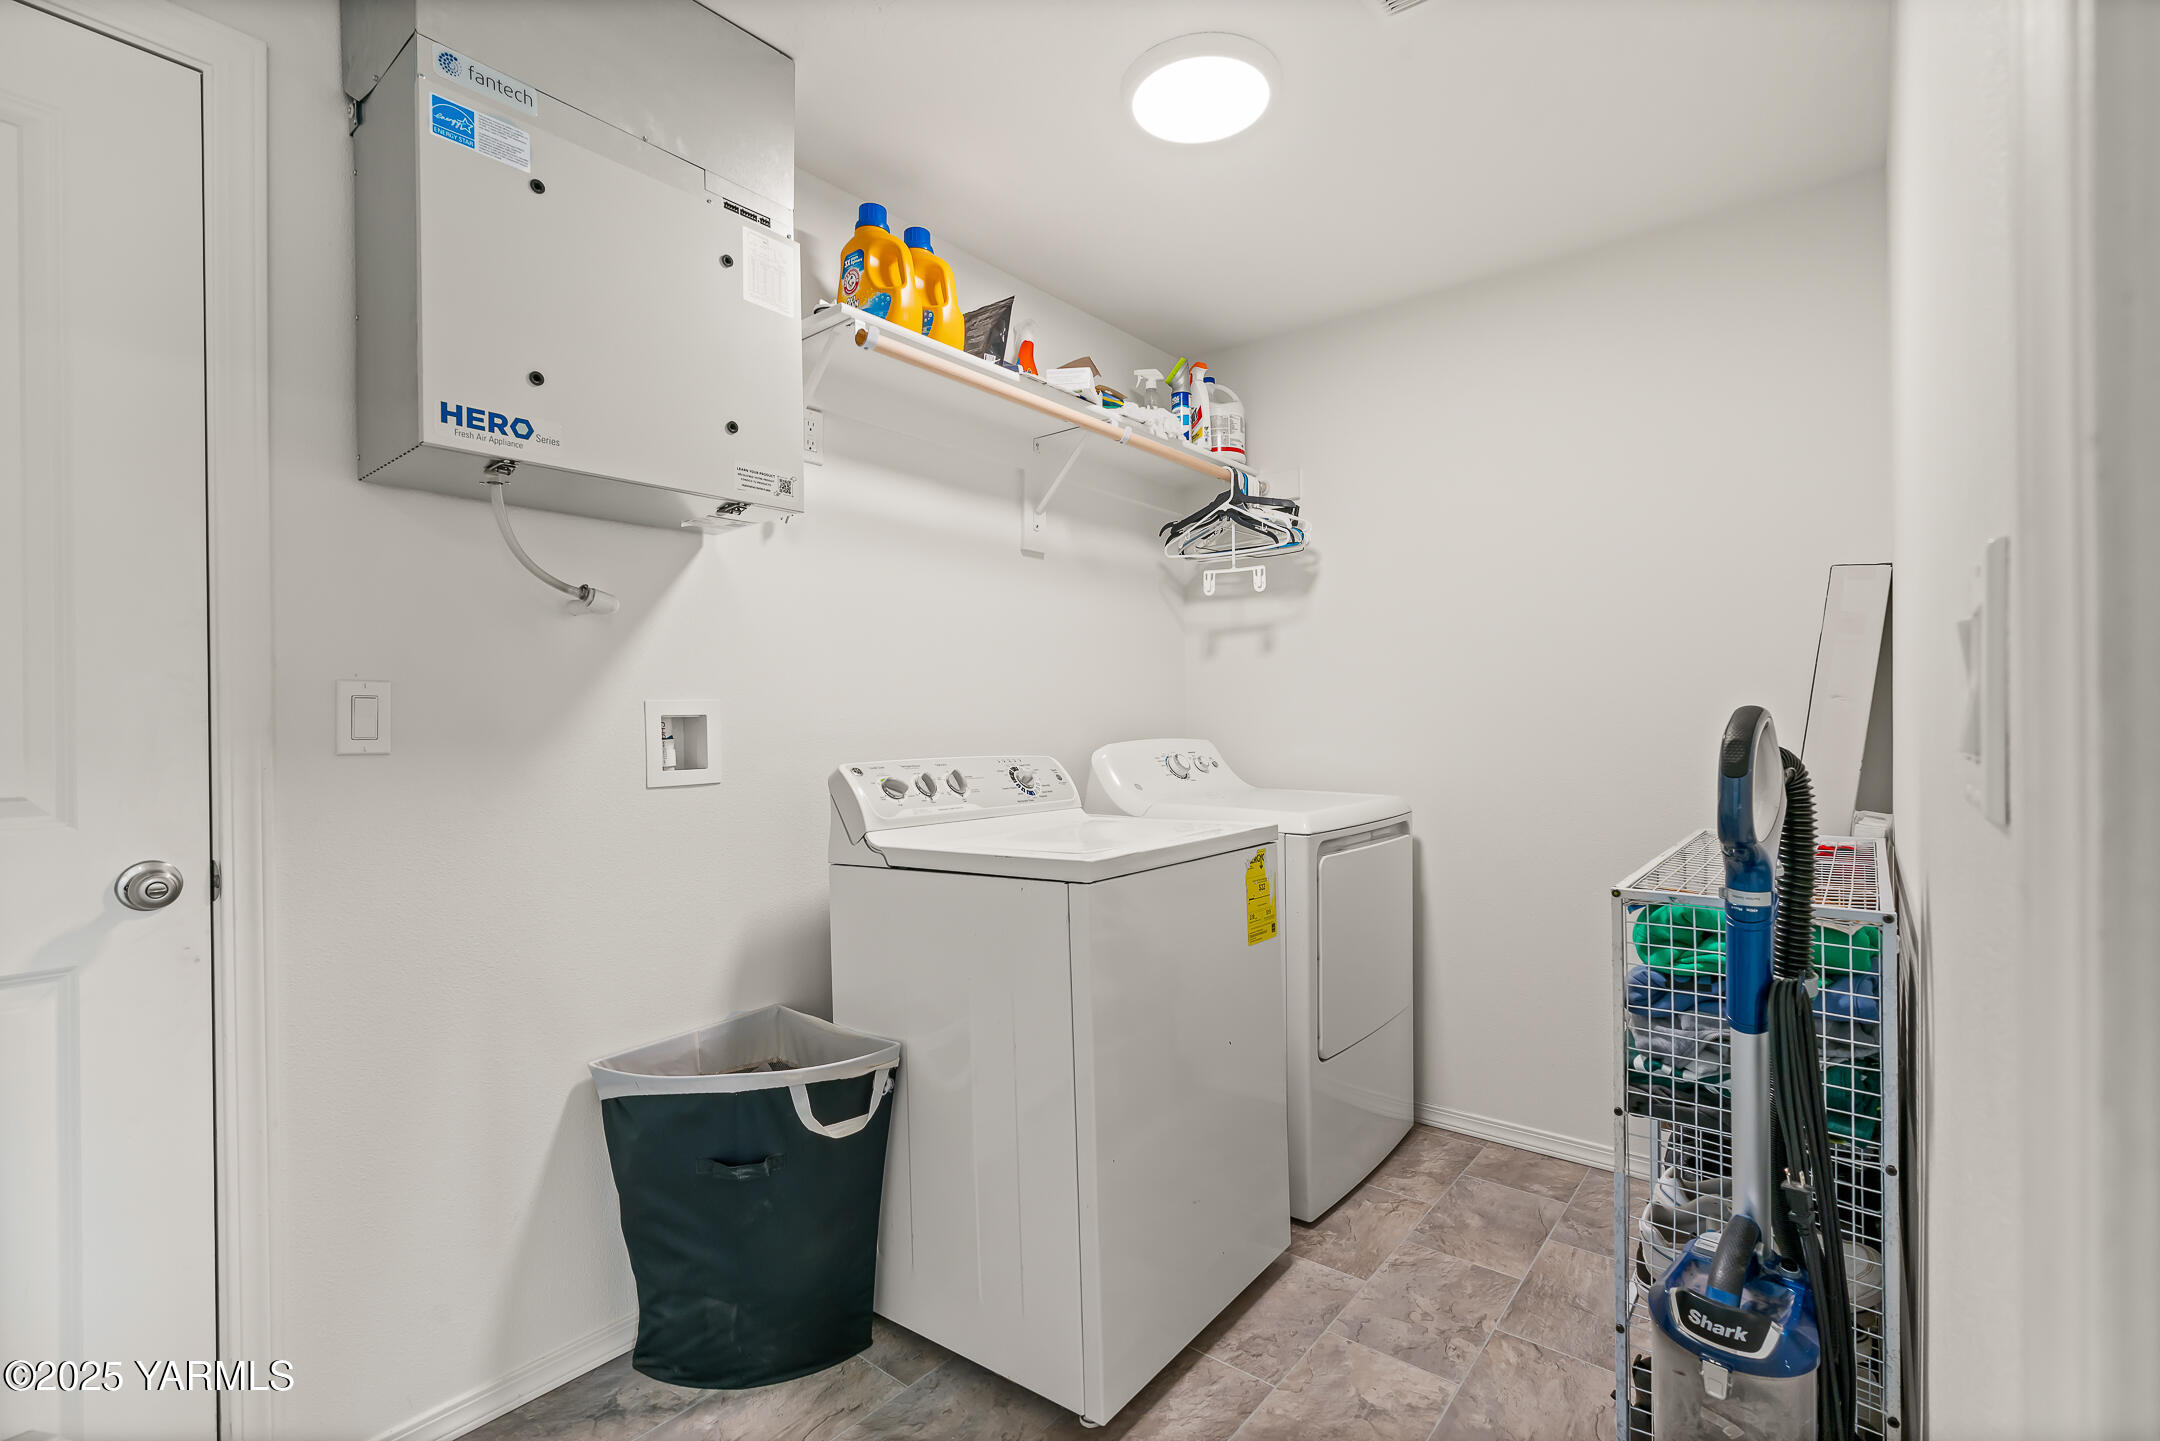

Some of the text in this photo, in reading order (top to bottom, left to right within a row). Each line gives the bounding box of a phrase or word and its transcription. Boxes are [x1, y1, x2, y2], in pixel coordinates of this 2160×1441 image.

[468, 65, 533, 107] fantech
[433, 126, 474, 147] ENERGY STAR
[440, 400, 534, 440] HERO
[454, 428, 524, 449] Fresh Air Appliance
[535, 433, 560, 447] Series
[1688, 1308, 1749, 1342] Shark
